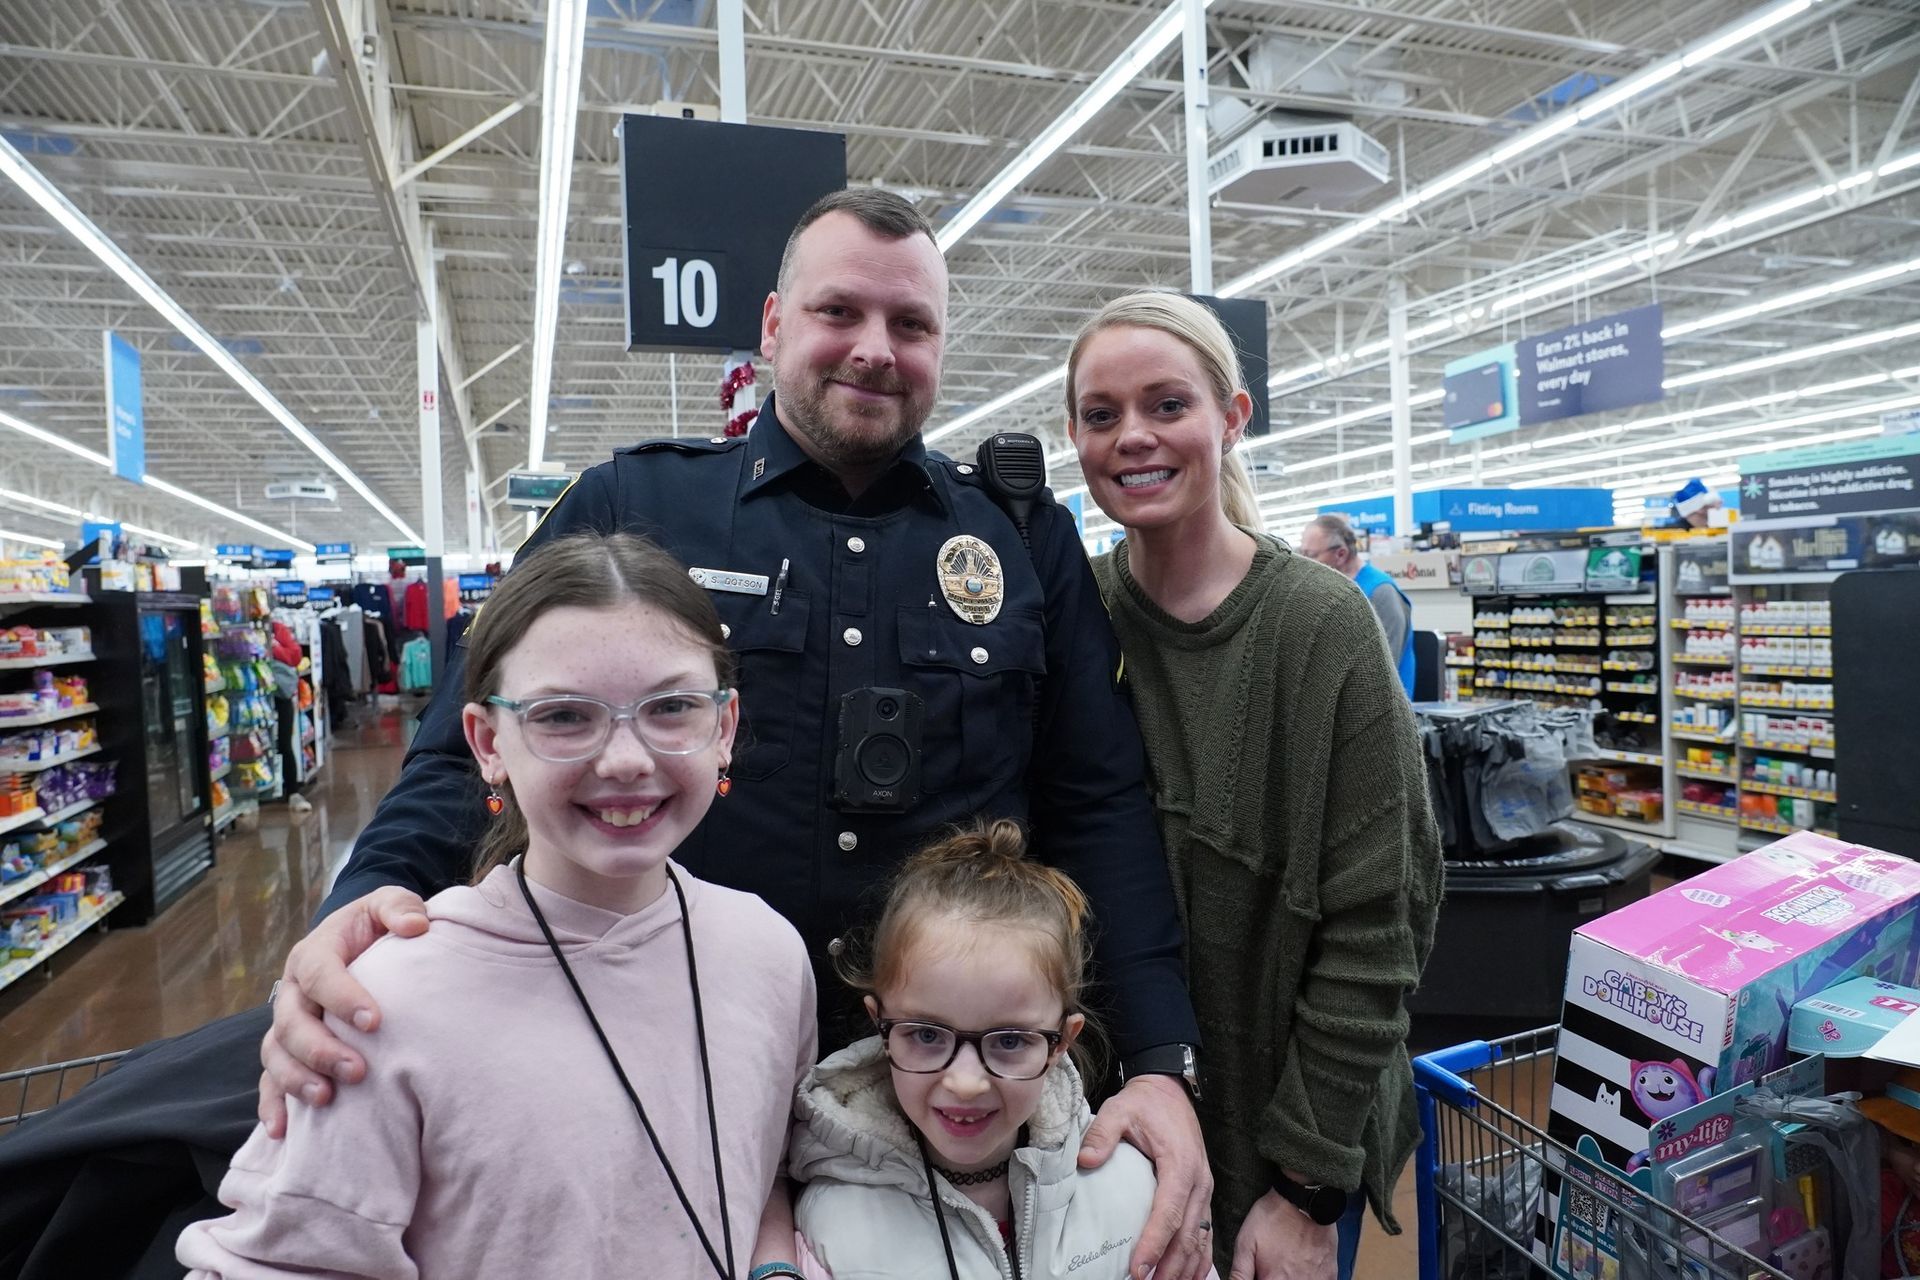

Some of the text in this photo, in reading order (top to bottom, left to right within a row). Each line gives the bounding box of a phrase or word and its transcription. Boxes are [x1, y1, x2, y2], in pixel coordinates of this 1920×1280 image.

[652, 257, 718, 328] 10
[1536, 322, 1629, 358] Earn 2% back in
[1536, 344, 1629, 374] Walmart stores,
[1537, 369, 1592, 392] every day
[1768, 476, 1810, 488] Smoking
[1811, 472, 1820, 483] is
[1821, 469, 1853, 484] highly
[1769, 477, 1914, 500] Nicotine is the addictive drug
[1468, 502, 1539, 518] Fitting Rooms
[1769, 501, 1779, 513] in
[711, 576, 763, 588] S. DOTSON
[1604, 970, 1688, 1018] GABBY'S
[1583, 975, 1704, 1044] DOLLHOUSE
[1724, 995, 1737, 1046] NETFLIX
[1066, 1237, 1132, 1275] Eddie Bauer
